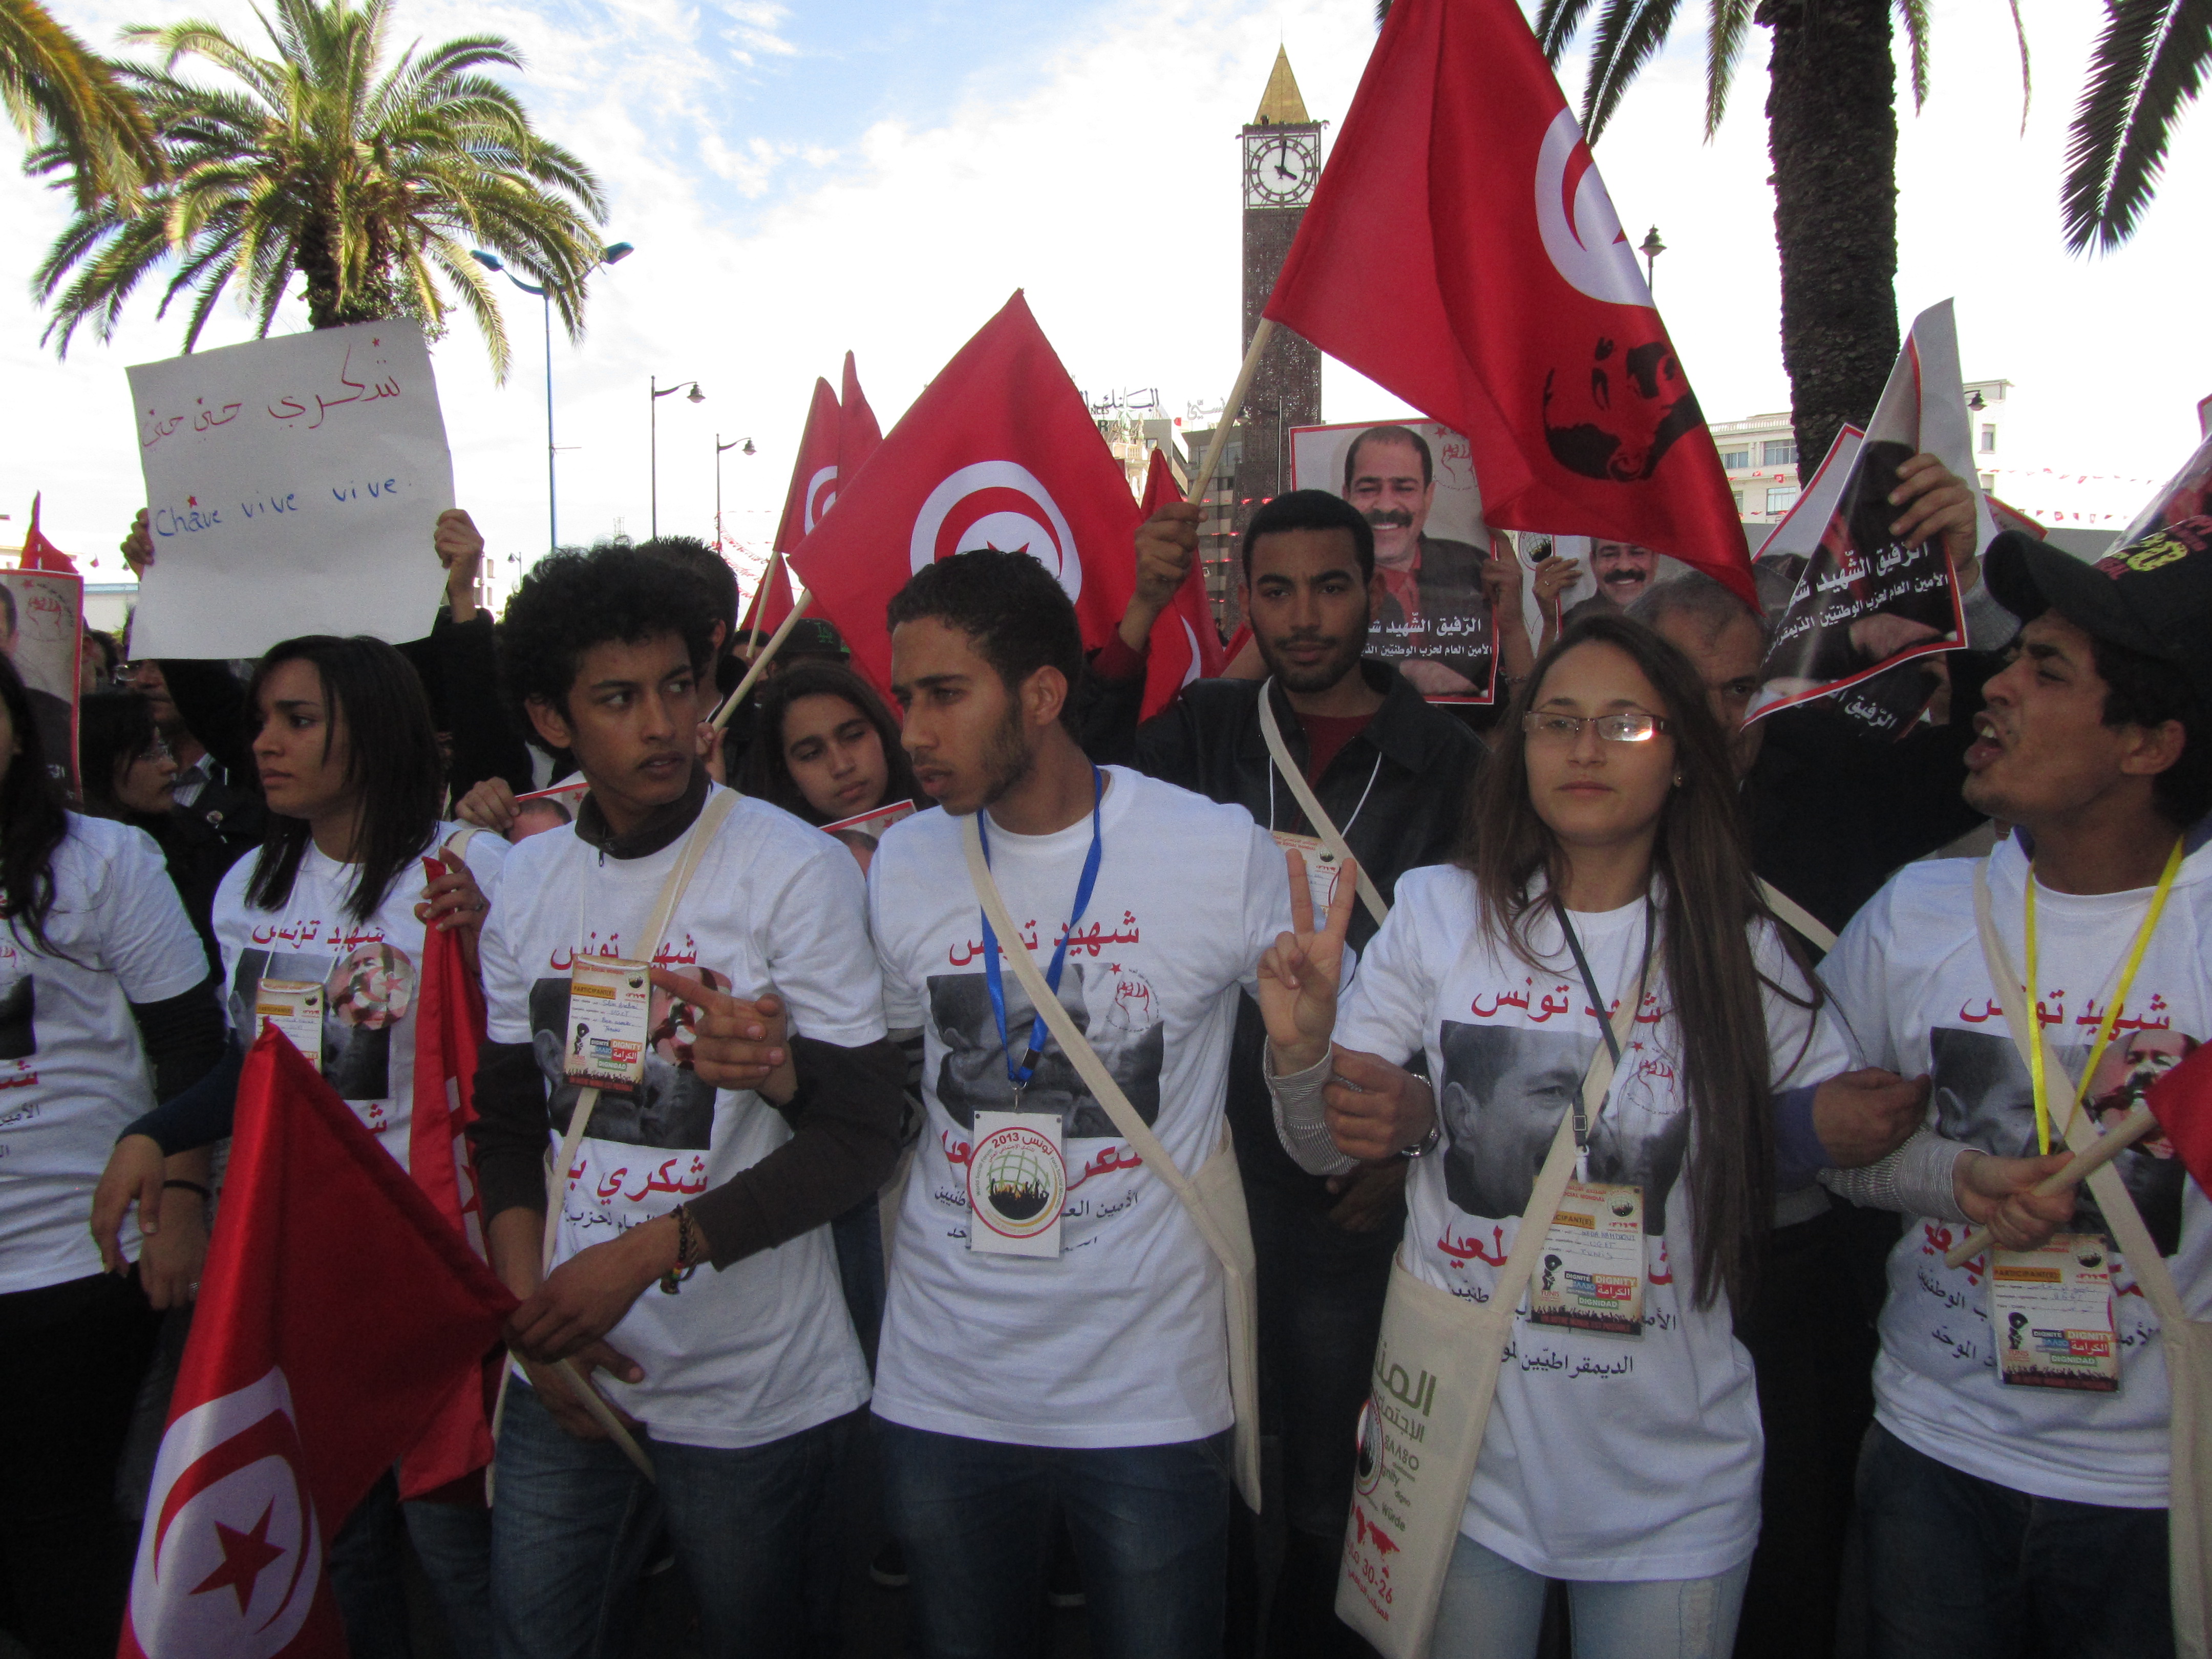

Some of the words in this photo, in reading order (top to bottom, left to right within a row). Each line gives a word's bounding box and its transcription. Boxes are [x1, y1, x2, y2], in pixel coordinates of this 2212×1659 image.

[1471, 976, 1570, 1023] تونس
[991, 1132, 1019, 1149] 2013
[1022, 1136, 1055, 1156] تونس
[597, 1155, 709, 1206] شكري
[1597, 1285, 1630, 1299] الكرامة
[1579, 1297, 1618, 1308] DIGNIDAD
